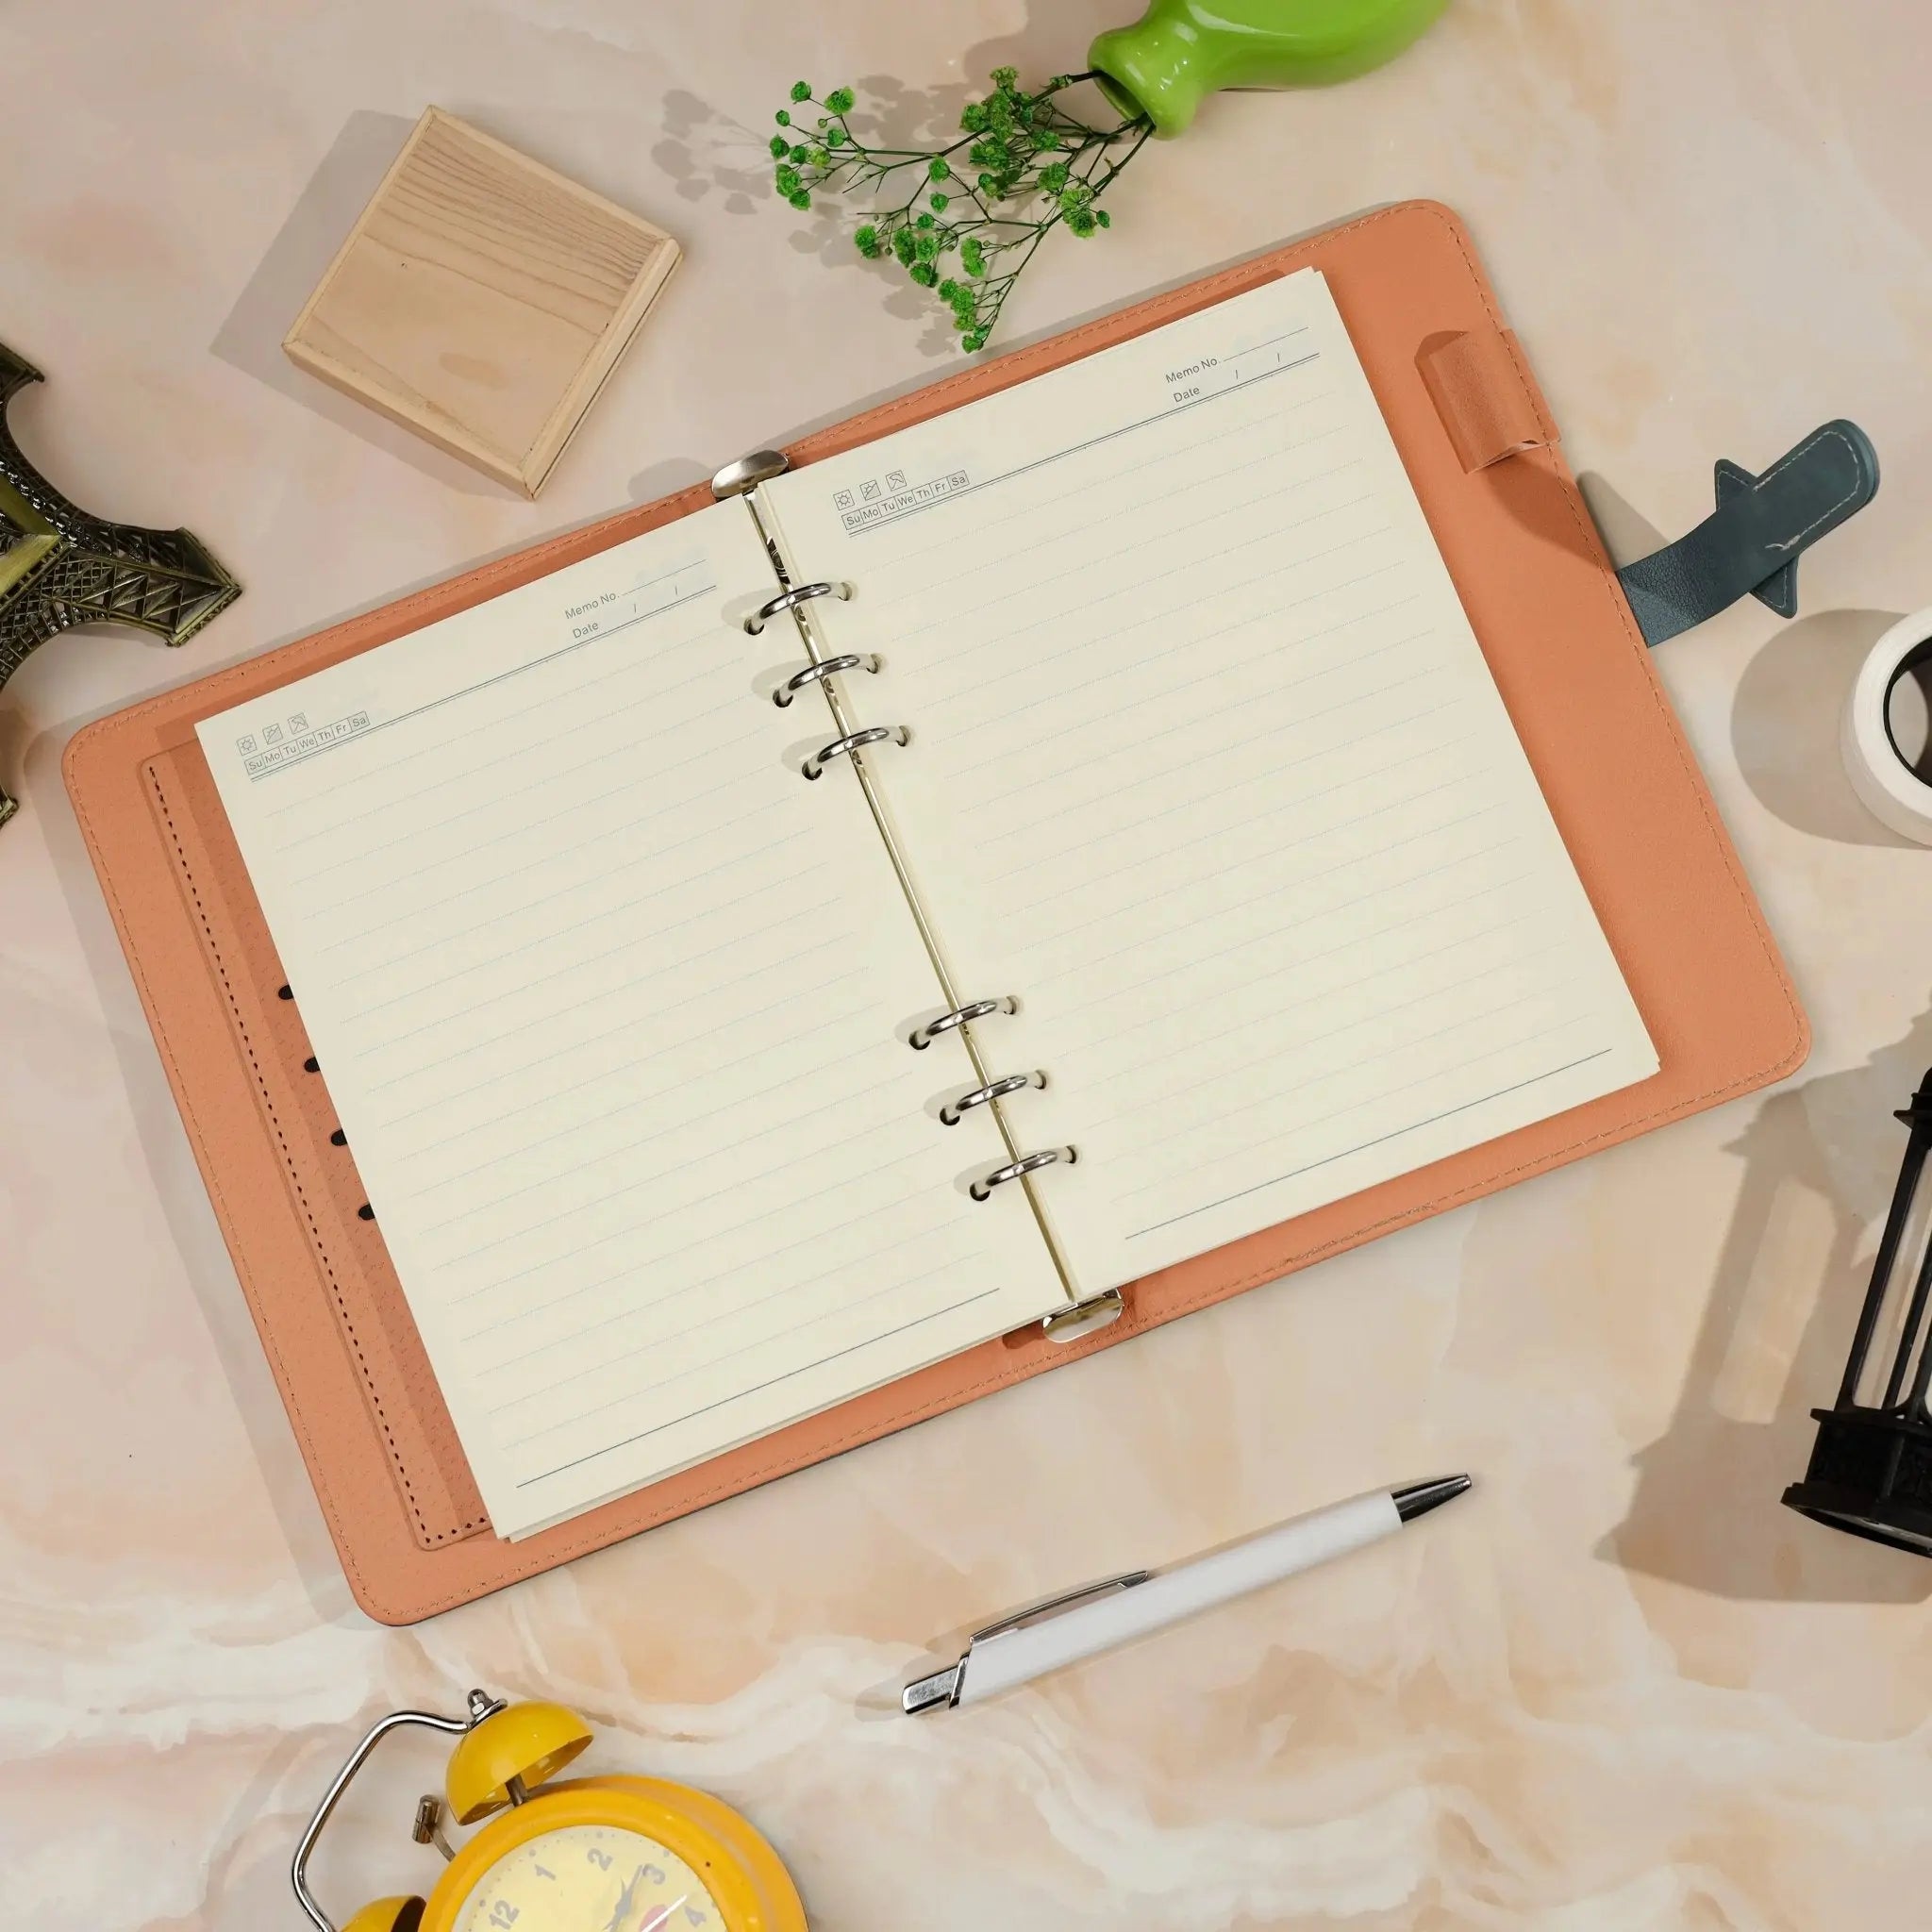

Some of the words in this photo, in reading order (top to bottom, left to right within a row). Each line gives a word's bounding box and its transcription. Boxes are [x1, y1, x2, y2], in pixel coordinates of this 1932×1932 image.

[1165, 364, 1200, 383] Memo
[1200, 358, 1221, 371] No.
[1173, 387, 1200, 403] Date
[846, 515, 861, 525] Su
[862, 508, 879, 520] Mo
[881, 502, 895, 512] Tu
[897, 495, 914, 506] We
[916, 489, 930, 499] Th
[934, 482, 945, 492] Fr
[951, 475, 966, 487] Sa
[564, 600, 599, 619] Memo
[599, 591, 620, 605] No.
[572, 622, 599, 639] Date
[248, 759, 263, 771] Su
[264, 751, 281, 763] Mo
[283, 745, 297, 756] Tu
[299, 738, 315, 749] We
[318, 730, 332, 741] Th
[335, 724, 347, 735] Fr
[352, 716, 366, 727] Sa
[534, 1863, 557, 1881] 1
[587, 1848, 613, 1872] 2
[642, 1862, 666, 1886] 3
[489, 1899, 520, 1930] 12
[685, 1905, 707, 1928] 4
